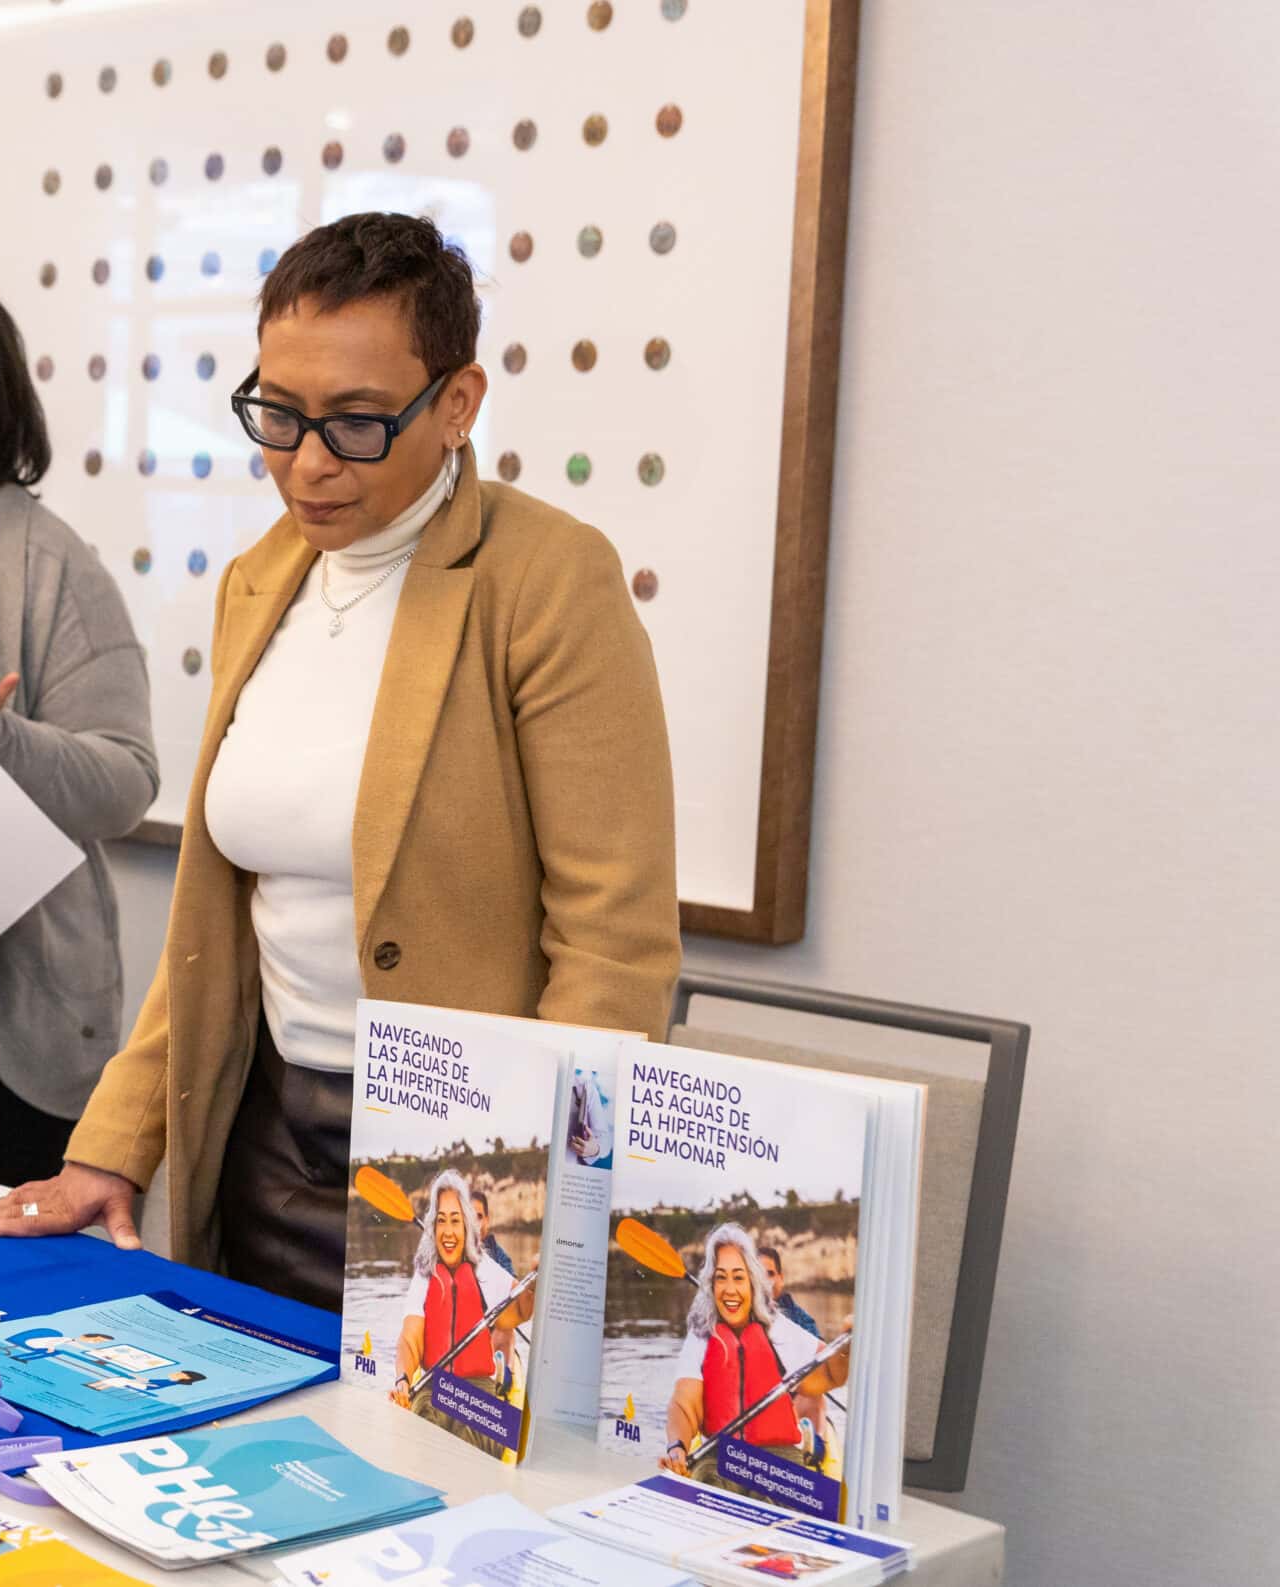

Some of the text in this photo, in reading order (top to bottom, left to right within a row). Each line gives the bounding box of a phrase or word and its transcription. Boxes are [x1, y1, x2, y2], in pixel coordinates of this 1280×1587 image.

[369, 1020, 463, 1059] NAVEGANDO
[368, 1041, 470, 1084] LAS AGUAS DE
[633, 1063, 742, 1105] NAVEGANDO
[366, 1083, 449, 1121] PULMONAR
[367, 1062, 491, 1113] LA HIPERTENSIÓN
[631, 1085, 751, 1131] LAS AGUAS DE
[629, 1129, 726, 1171] PULMONAR
[630, 1107, 780, 1163] LA HIPERTENSIÓN
[354, 1354, 377, 1377] PHA
[437, 1393, 508, 1438] recién diagnosticados
[439, 1376, 502, 1419] Guía para pacientes
[615, 1419, 641, 1443] PHA
[725, 1461, 824, 1511] recién diagnosticados
[726, 1444, 815, 1491] Guía para pacientes
